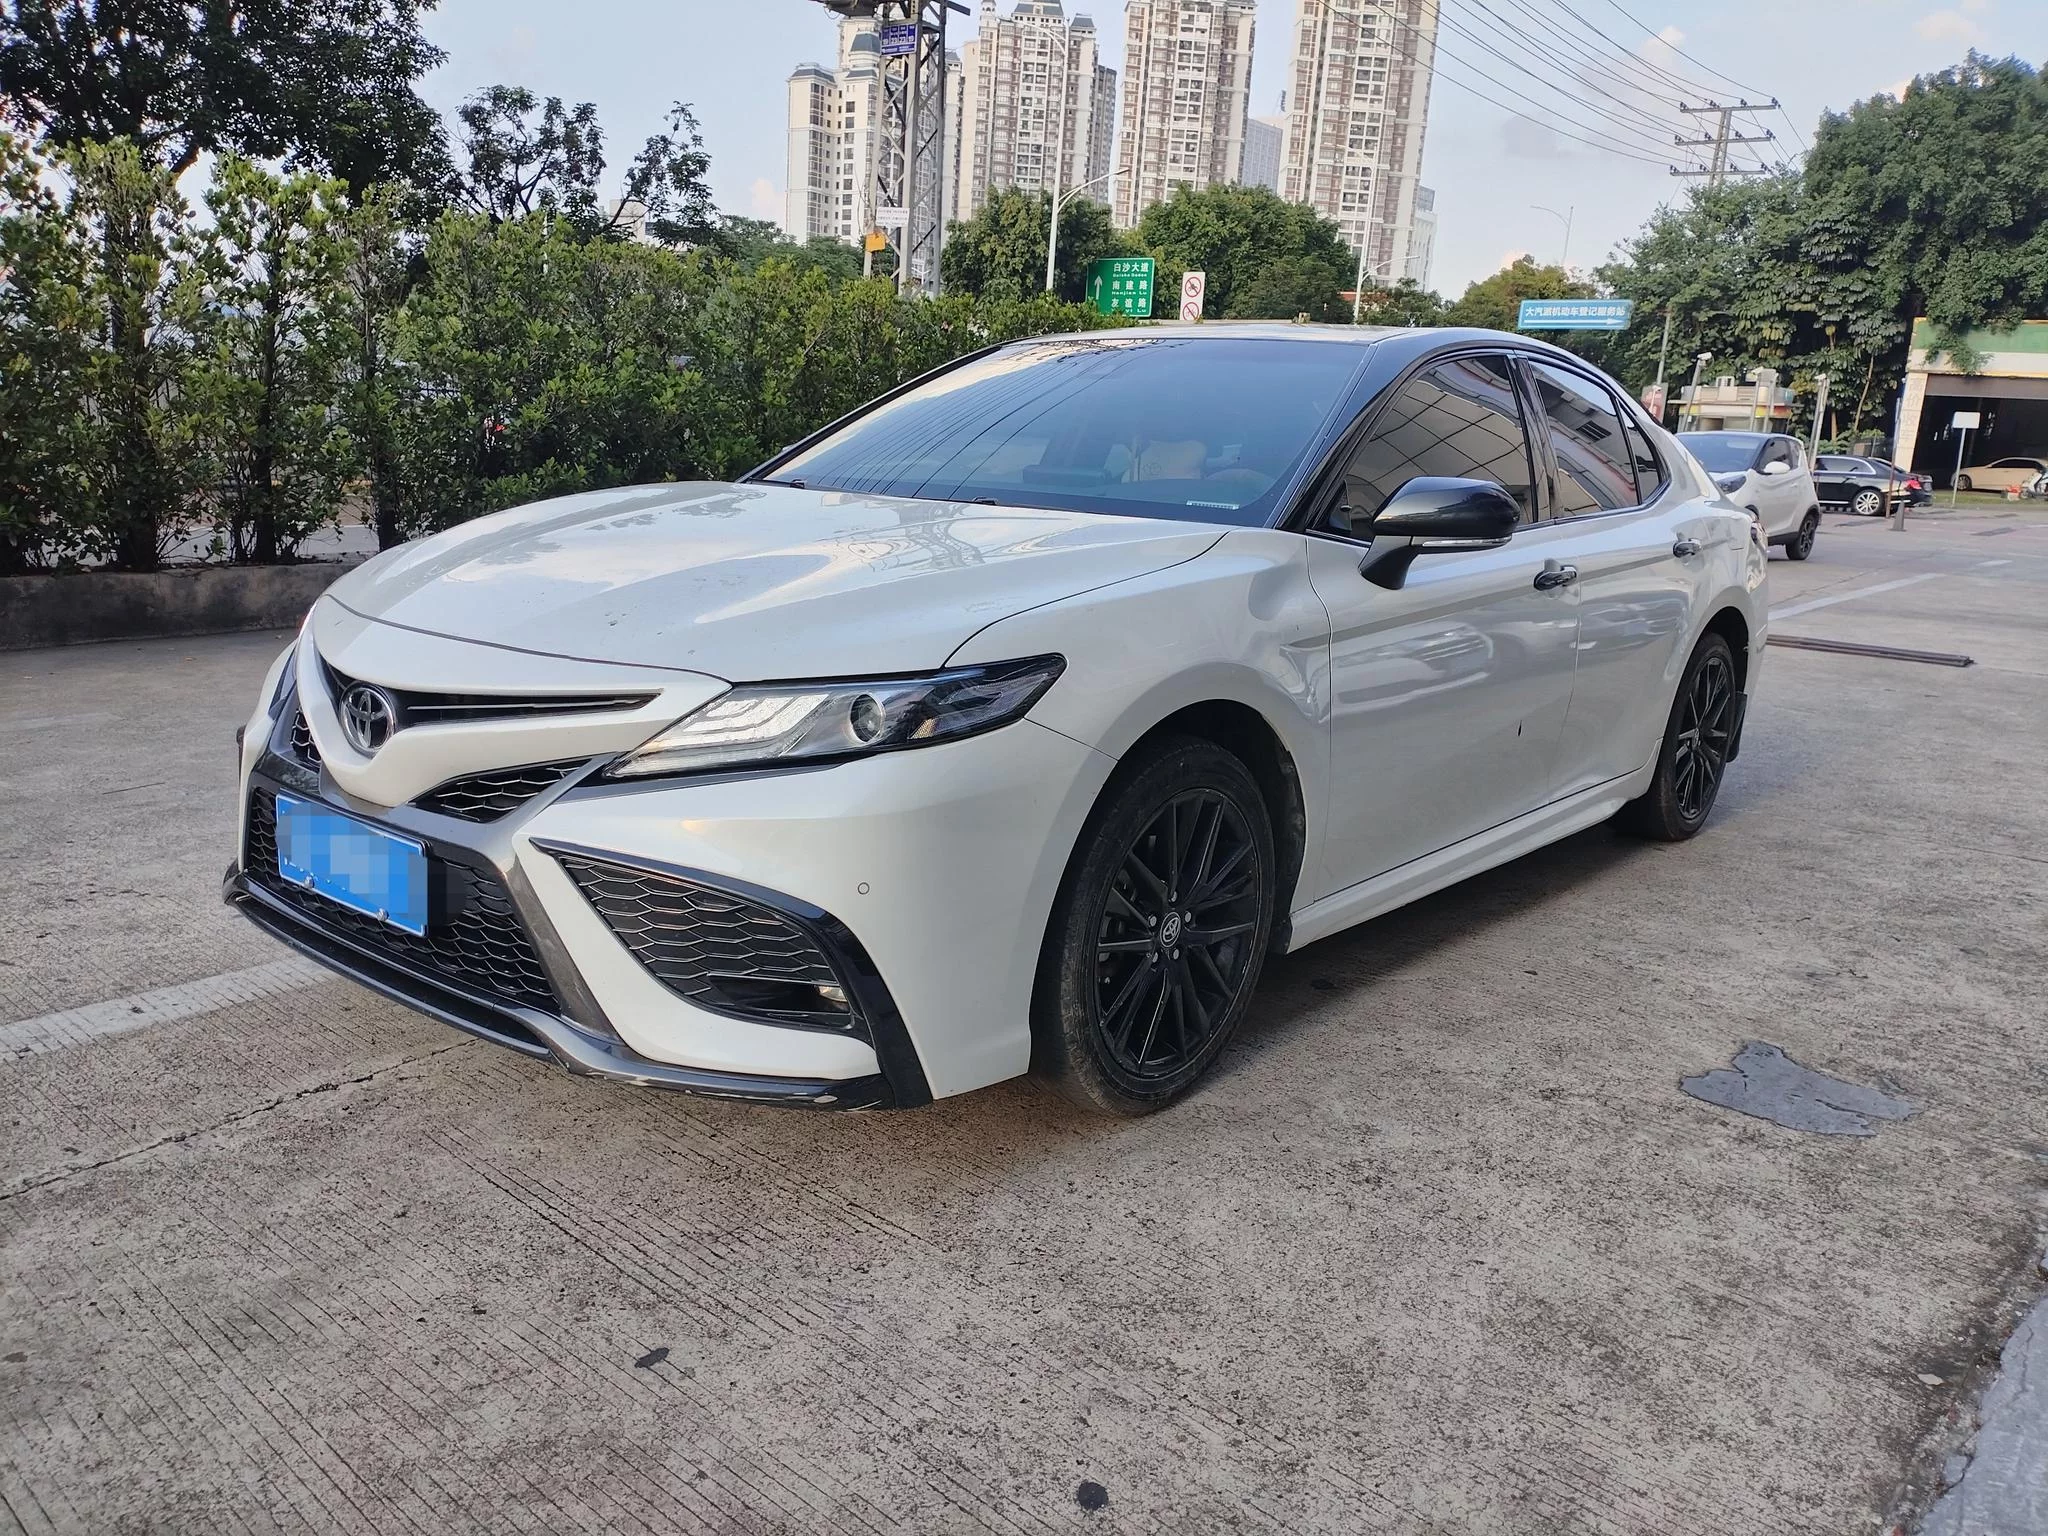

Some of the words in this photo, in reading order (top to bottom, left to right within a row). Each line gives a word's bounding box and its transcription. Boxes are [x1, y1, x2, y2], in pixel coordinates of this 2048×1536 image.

[1113, 262, 1149, 272] 白沙大道
[1112, 280, 1148, 290] 南建路
[1111, 298, 1147, 308] 友谊路
